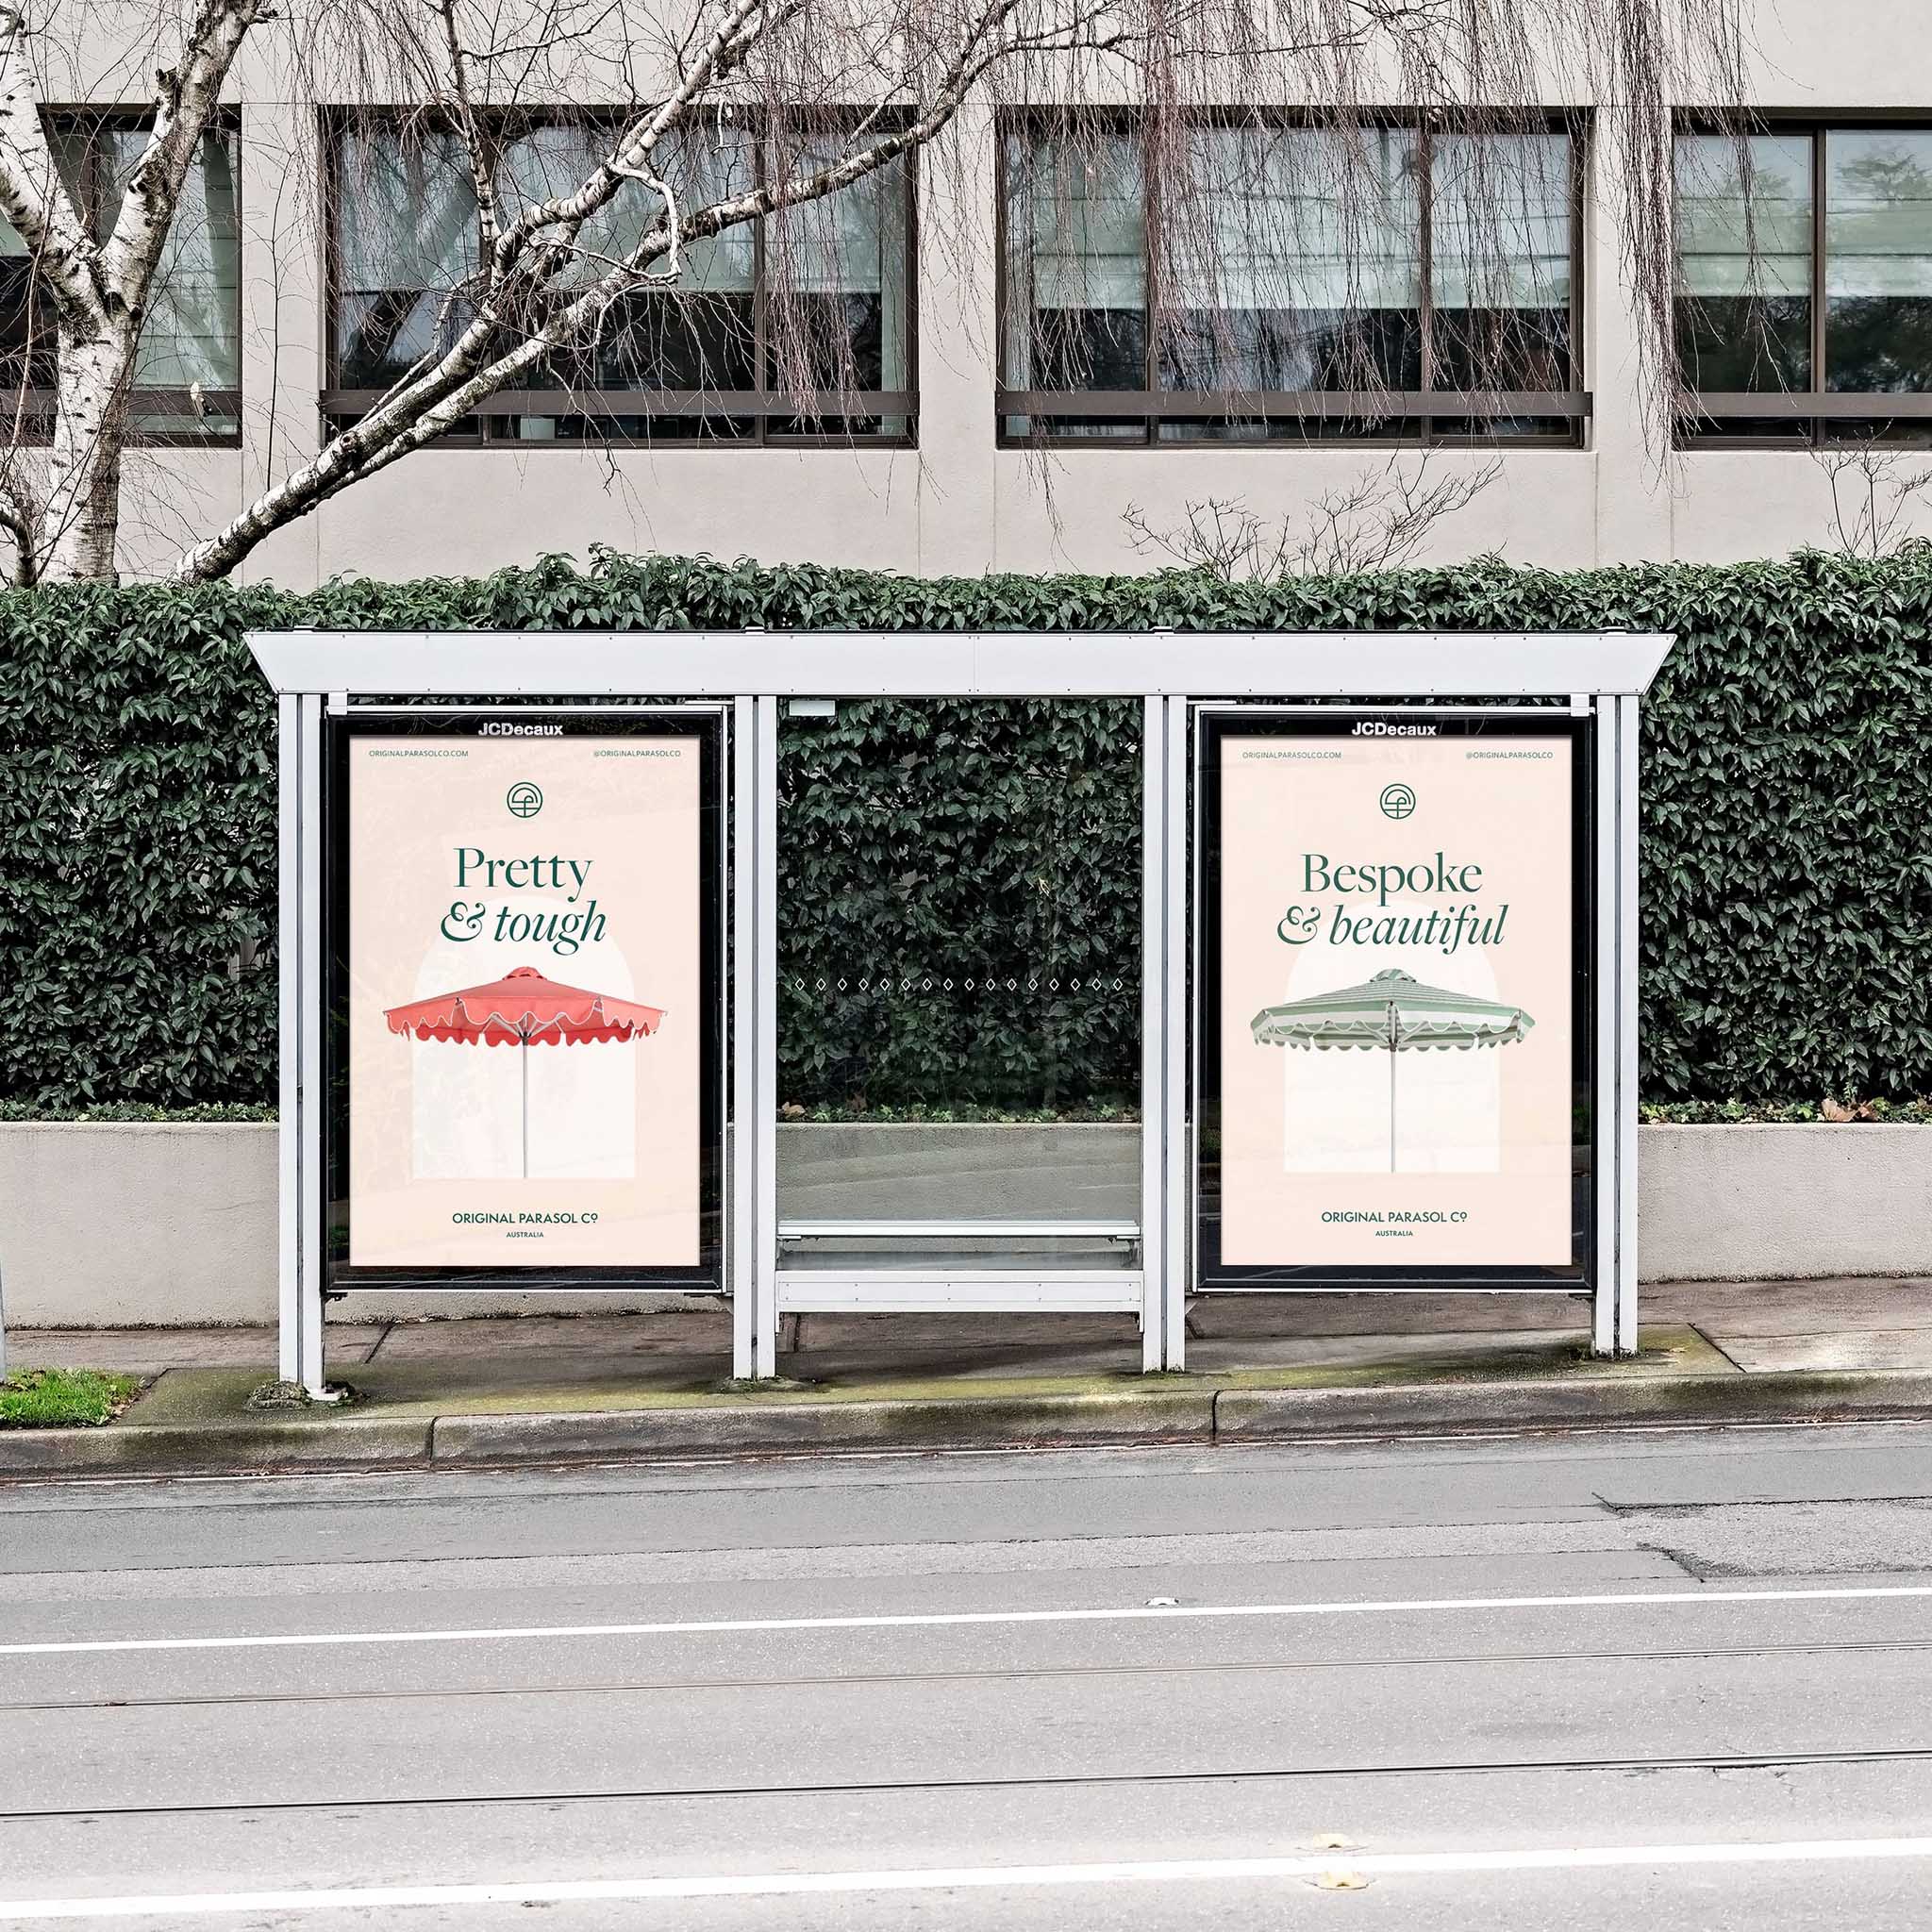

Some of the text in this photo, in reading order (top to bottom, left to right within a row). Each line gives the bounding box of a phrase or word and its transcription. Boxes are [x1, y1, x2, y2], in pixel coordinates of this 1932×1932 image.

[477, 723, 564, 736] JCDecaux
[1350, 722, 1438, 736] JCDecaux
[1241, 751, 1341, 759] ORIGINALPARASOLCO.COM
[1465, 751, 1554, 759] @ORIGINALPARASOLCO
[453, 847, 594, 902] Pretty
[1300, 851, 1483, 908] Bespoke
[440, 899, 607, 957] & tough
[1276, 902, 1510, 955] & beautiful
[452, 1212, 516, 1224] ORIGINAL
[518, 1212, 579, 1224] PARASOL
[1321, 1211, 1386, 1224] ORIGINAL
[1388, 1211, 1448, 1224] PARASOL
